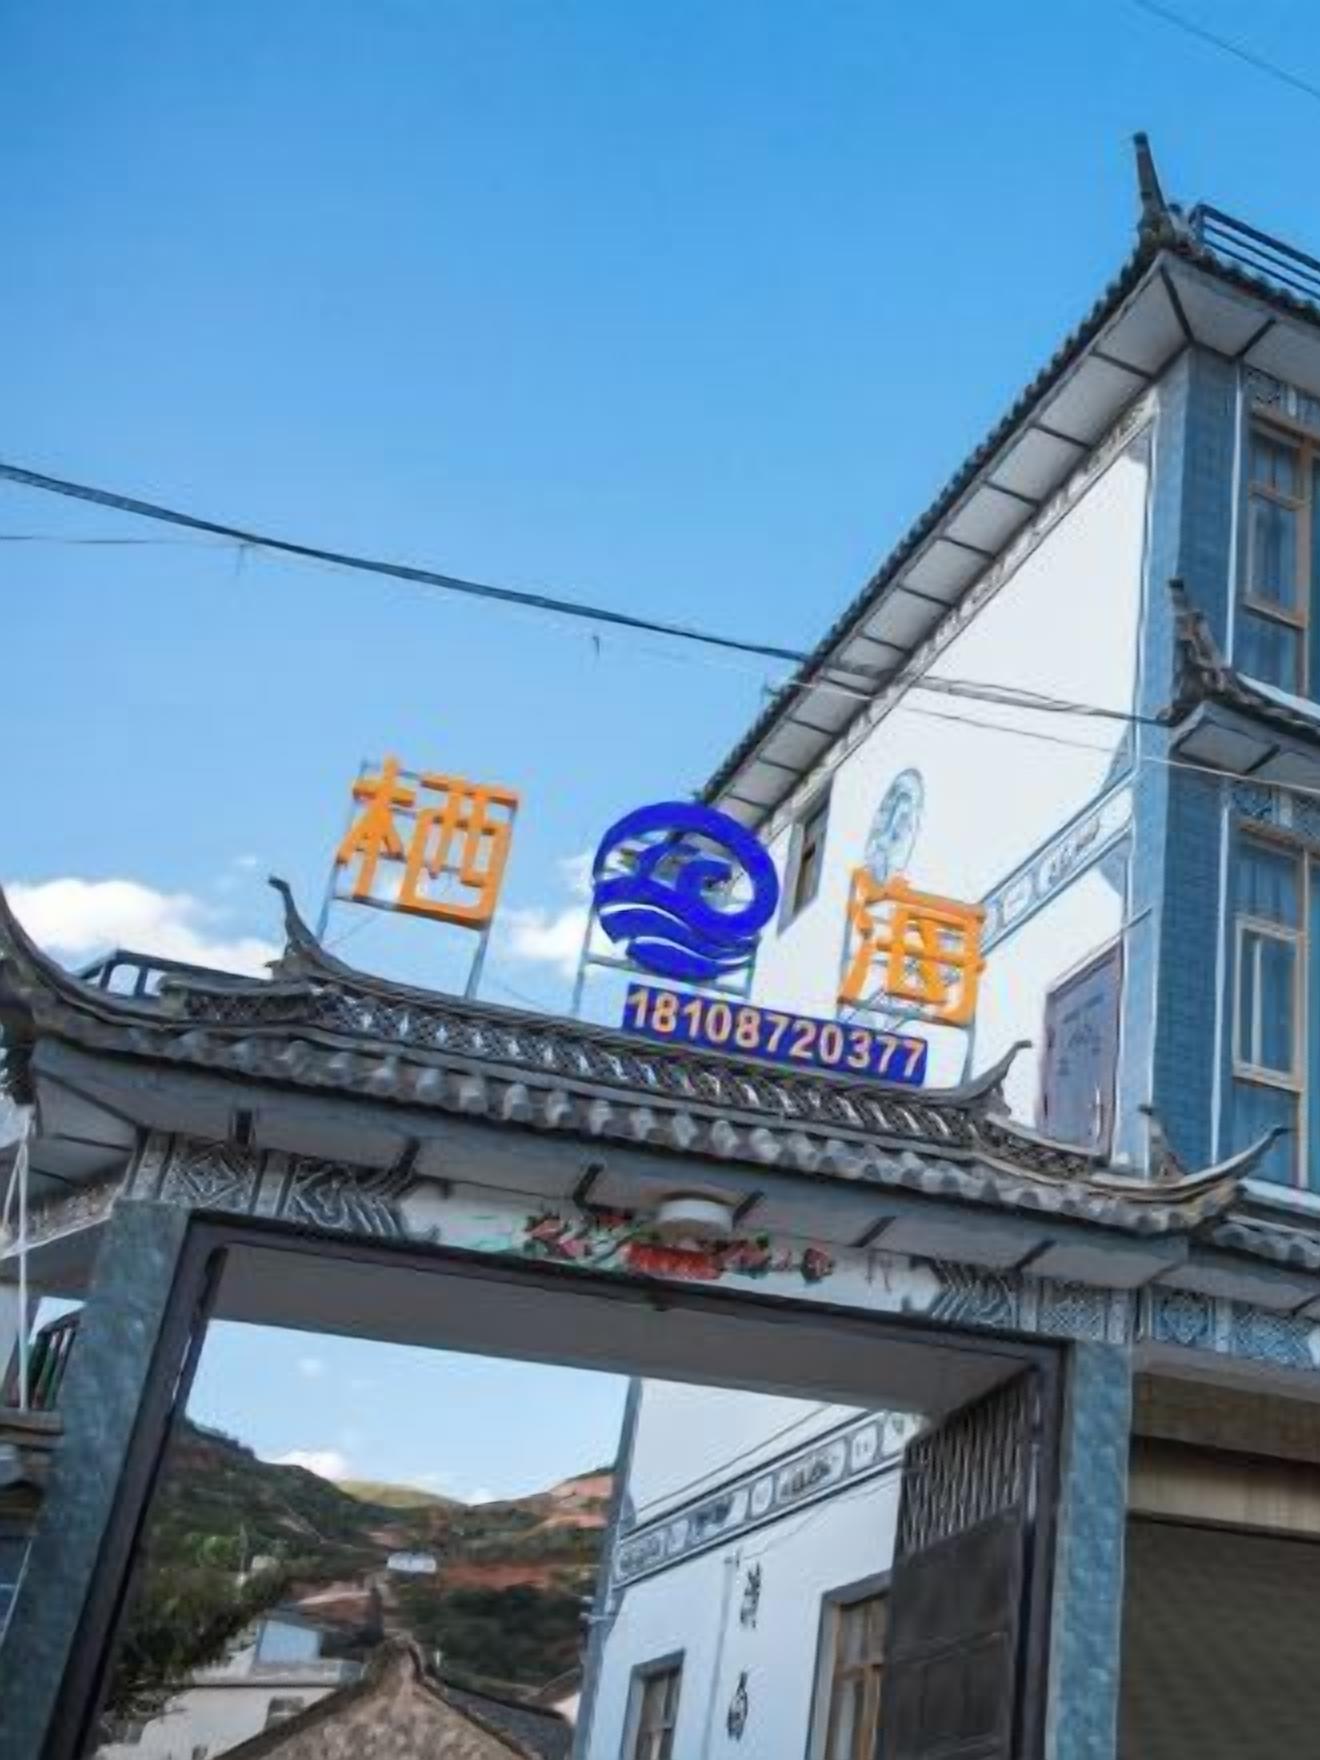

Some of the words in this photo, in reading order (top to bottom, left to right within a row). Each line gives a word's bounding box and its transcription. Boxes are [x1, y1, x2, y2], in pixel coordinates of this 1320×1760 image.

[335, 755, 520, 931] 栖
[837, 870, 986, 1027] 海
[626, 988, 927, 1079] 18108720377
